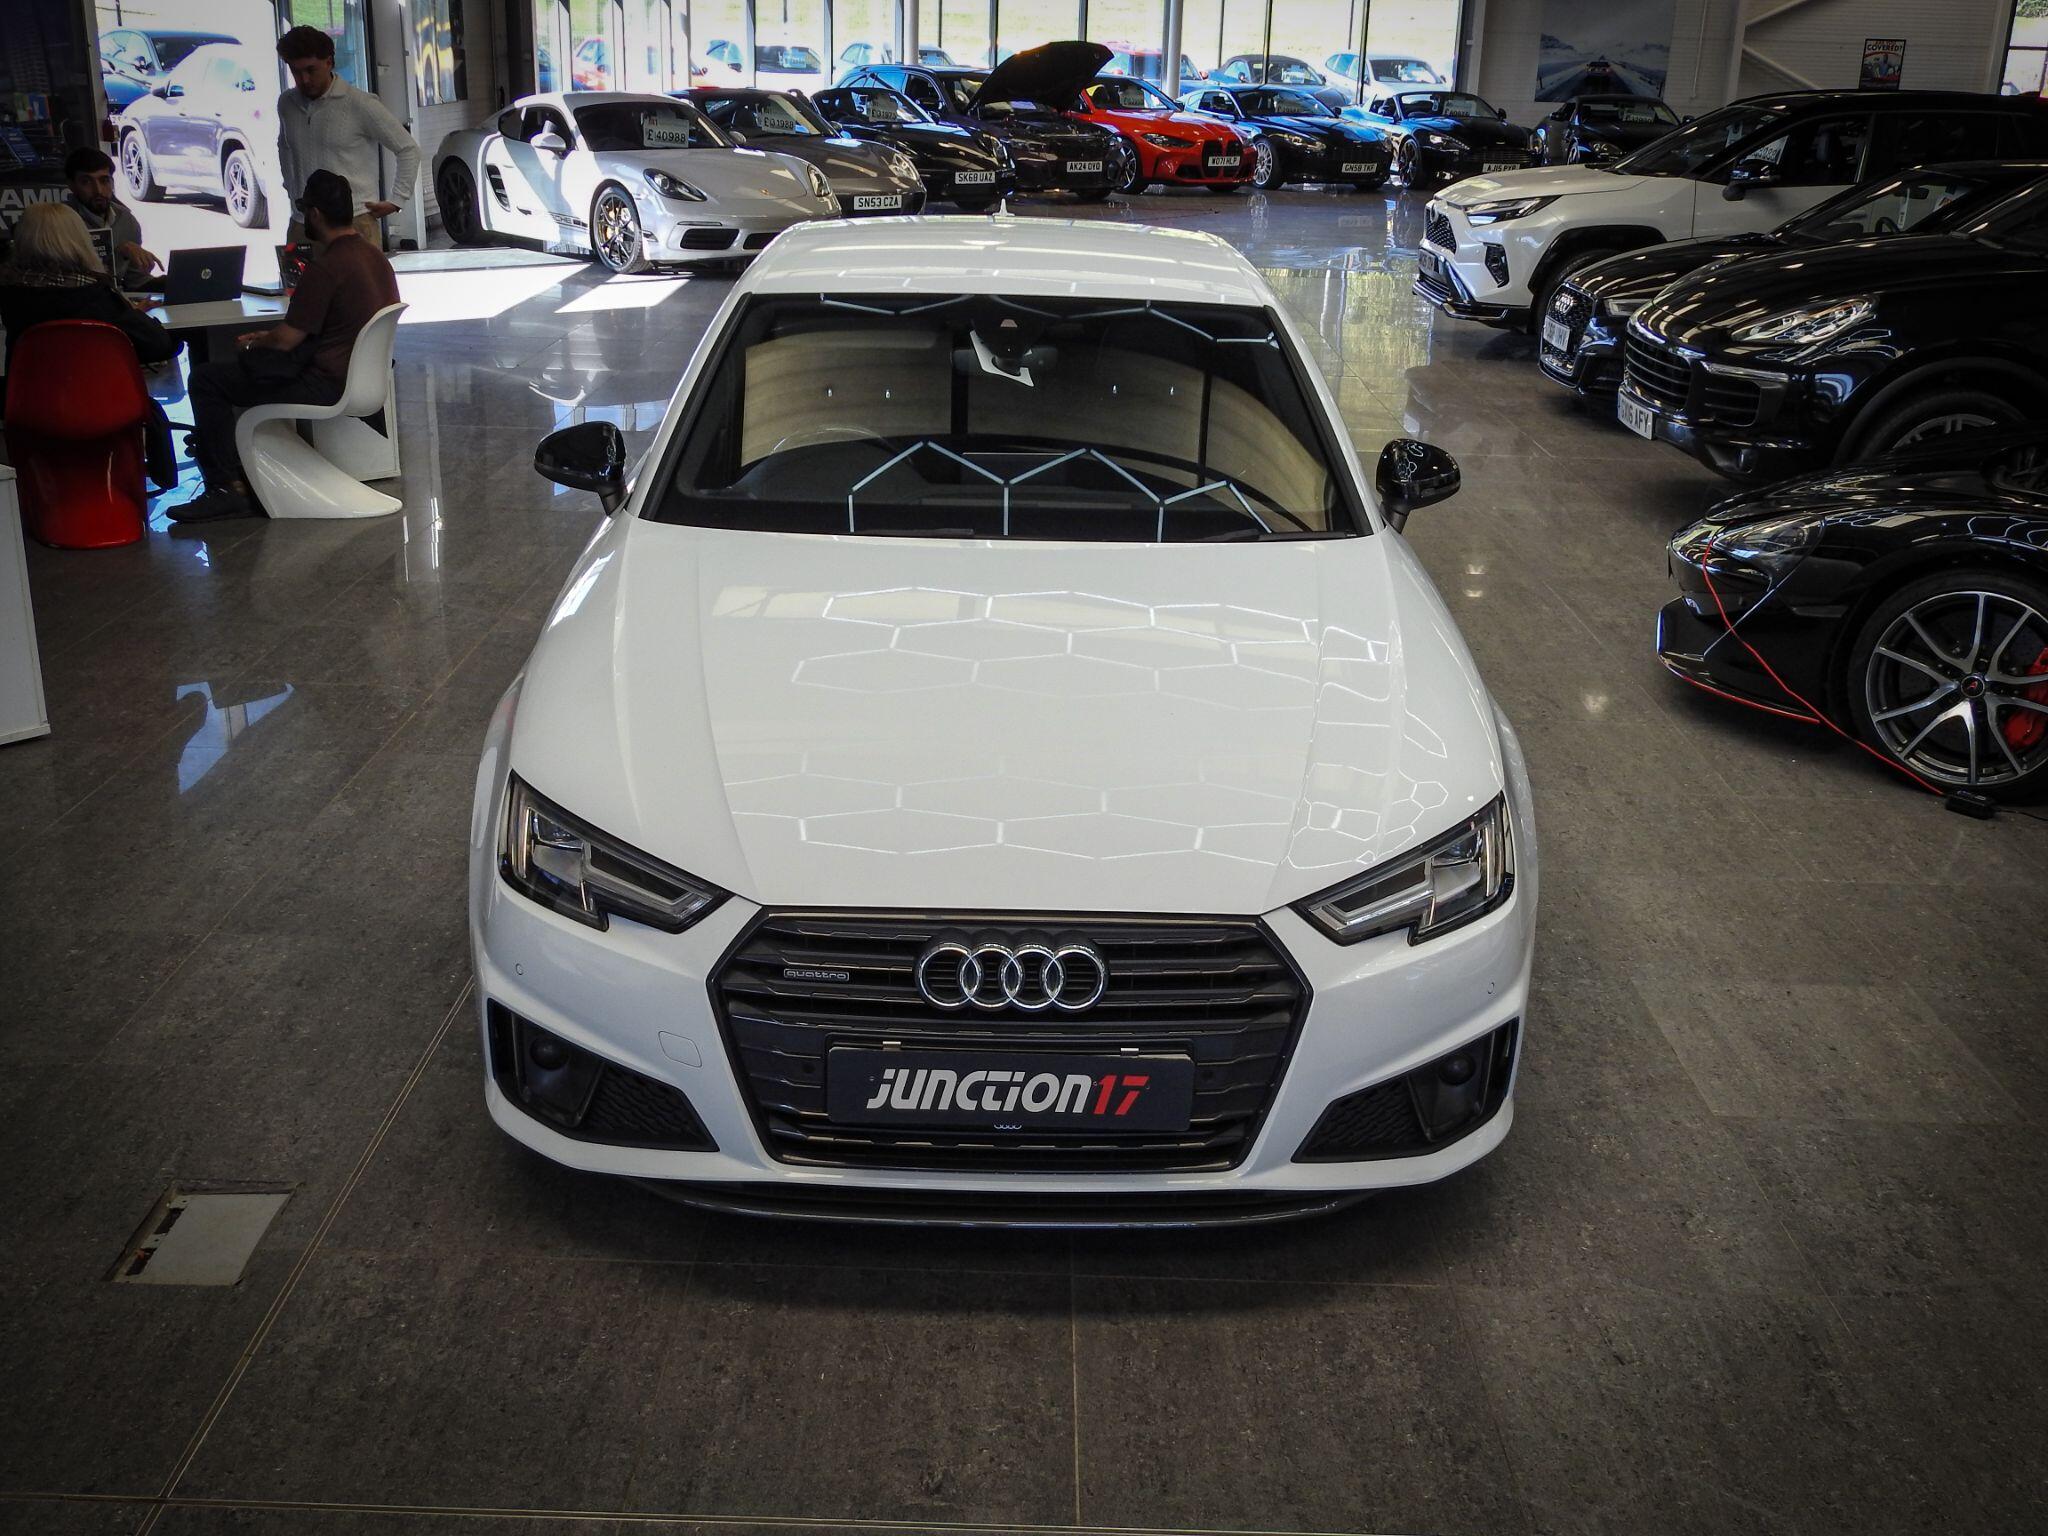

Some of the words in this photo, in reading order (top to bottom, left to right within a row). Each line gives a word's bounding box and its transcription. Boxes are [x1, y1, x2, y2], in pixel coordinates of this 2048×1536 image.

[647, 128, 687, 143] £40988
[1069, 162, 1086, 171] AK24
[979, 172, 993, 182] UAZ
[858, 197, 882, 208] SN53
[883, 196, 899, 207] CZA
[1634, 406, 1650, 433] AFY
[786, 970, 847, 979] quattro
